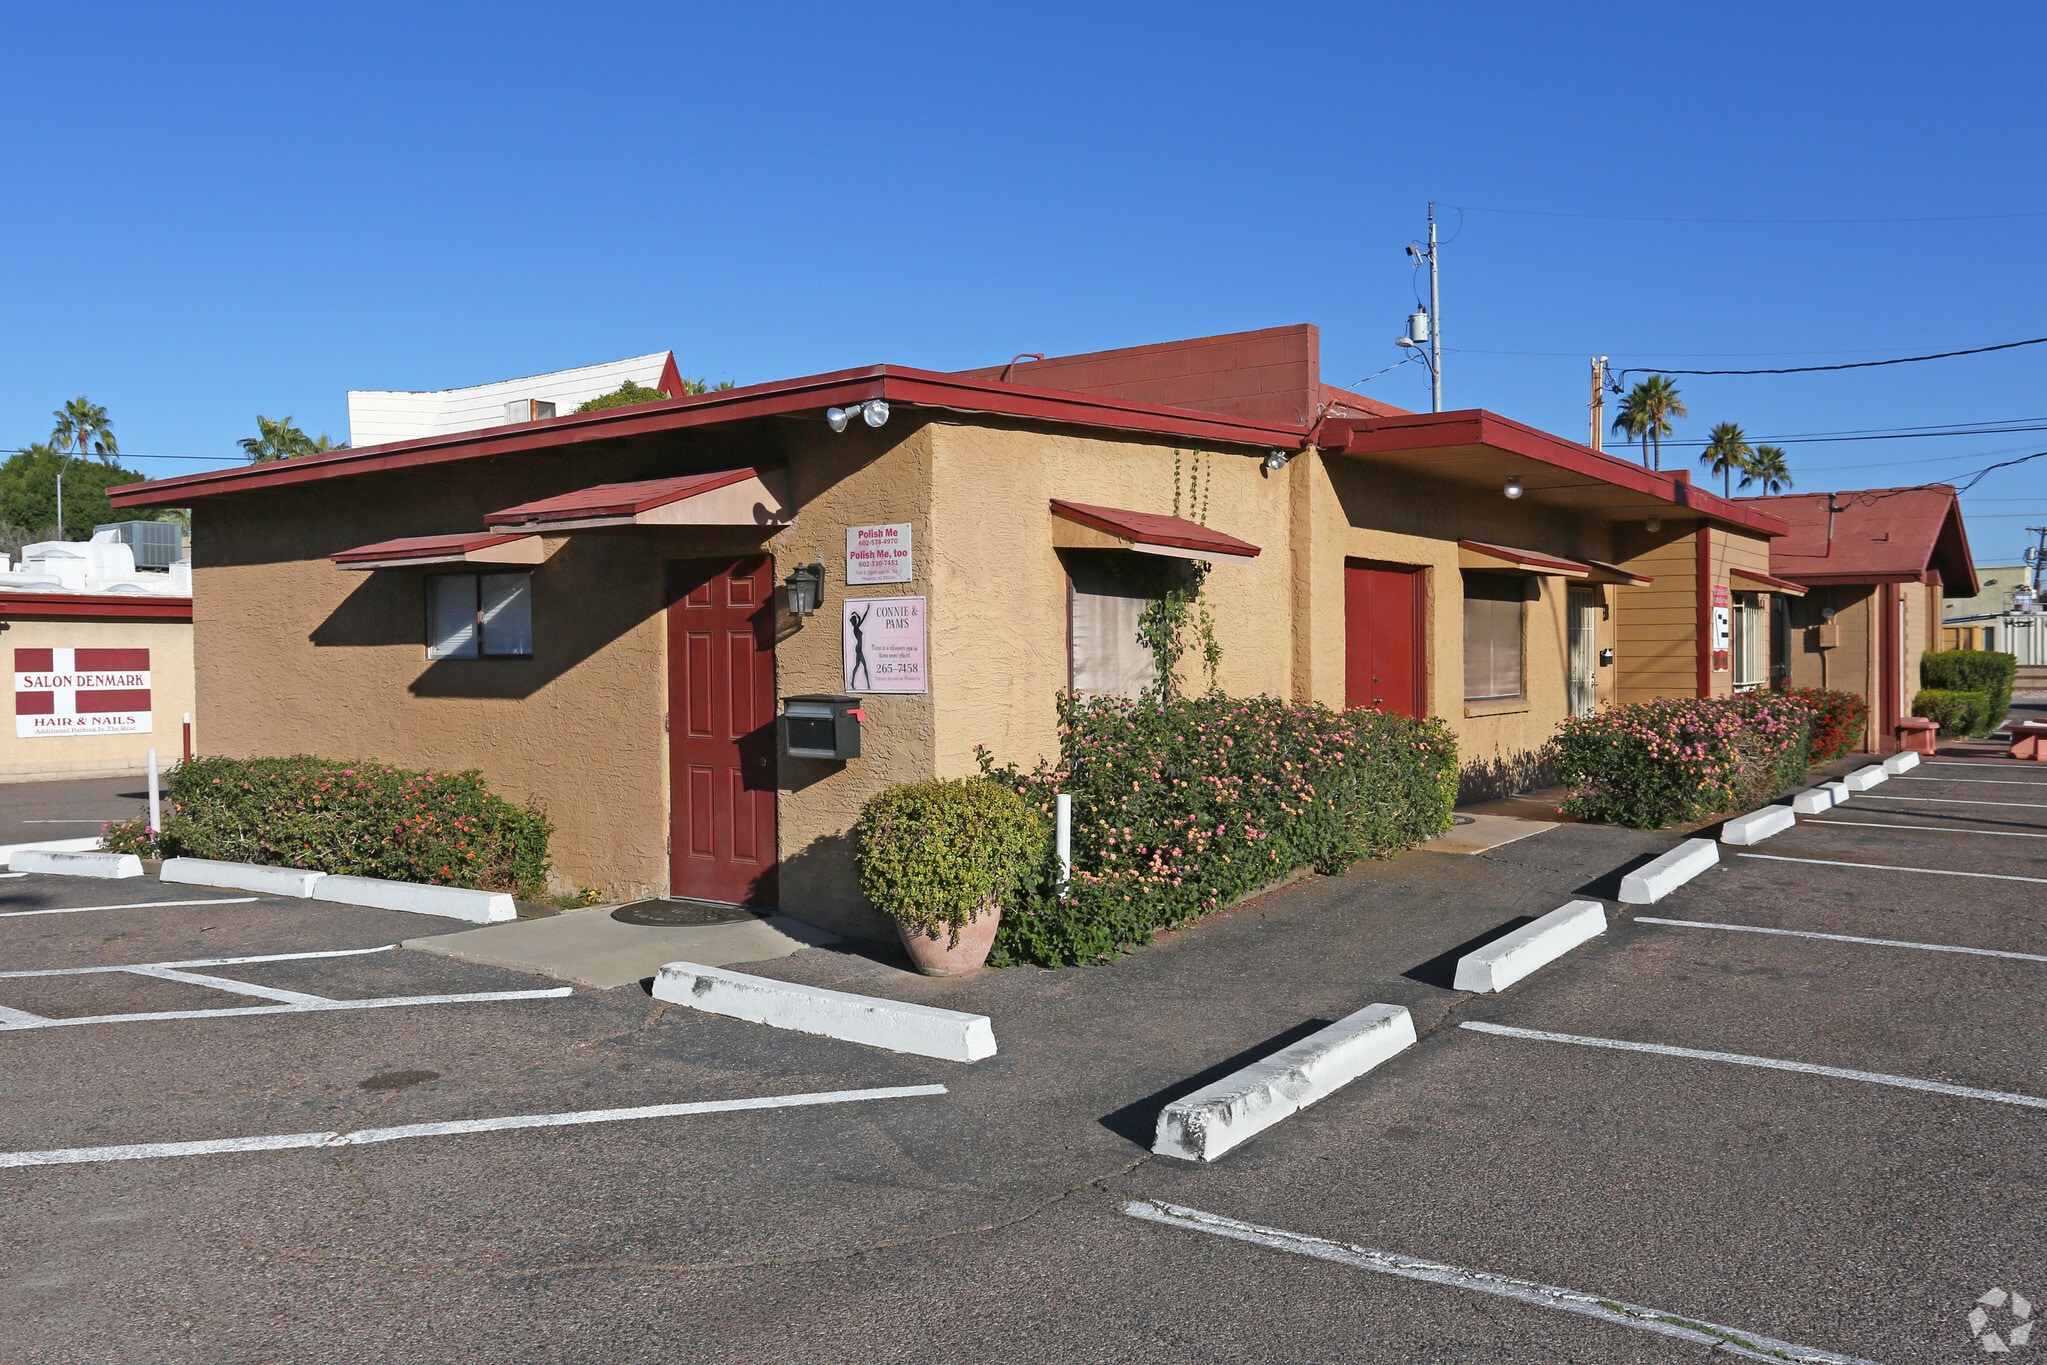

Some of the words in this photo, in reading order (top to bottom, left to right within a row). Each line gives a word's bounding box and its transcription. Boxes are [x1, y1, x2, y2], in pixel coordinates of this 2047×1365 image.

[858, 529, 883, 539] Polish
[885, 528, 898, 537] Me
[850, 550, 875, 560] Polish
[877, 549, 892, 559] Me,
[893, 548, 908, 558] too
[858, 559, 899, 568] 602-330-7451
[876, 606, 909, 617] CONNIE
[911, 605, 918, 616] &
[885, 618, 909, 629] PAM'S
[876, 663, 919, 673] 265-7458
[24, 675, 73, 688] SALON
[77, 674, 144, 687] DENMARK
[34, 717, 72, 727] HAIR
[76, 716, 87, 726] &
[92, 715, 136, 725] NAILS
